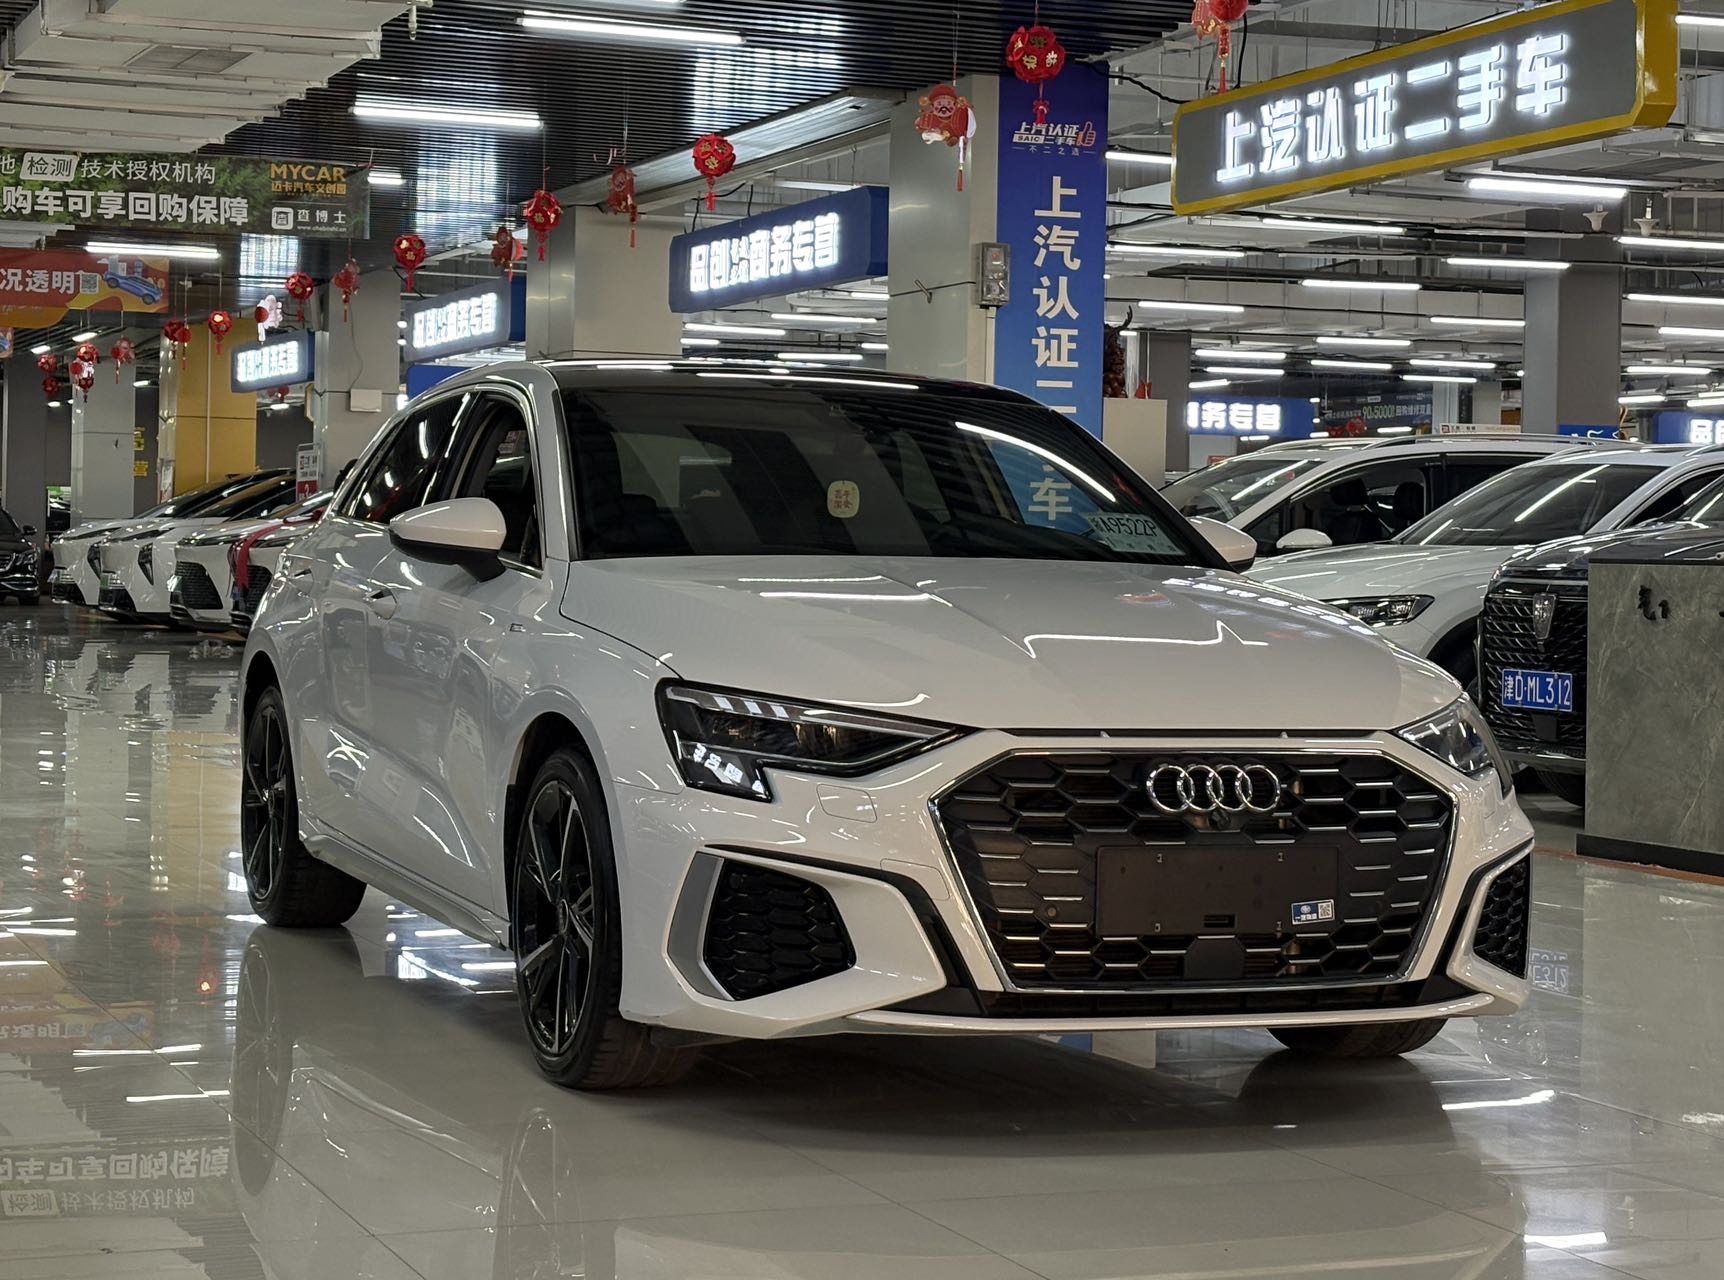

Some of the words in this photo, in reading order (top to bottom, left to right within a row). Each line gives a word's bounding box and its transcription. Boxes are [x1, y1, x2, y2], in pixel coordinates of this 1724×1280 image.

[1216, 33, 1568, 182] 上汽认证二手车
[1014, 121, 1080, 137] 上汽认证
[1015, 135, 1043, 143] SAIC
[1044, 136, 1078, 146] 二手车
[26, 156, 75, 178] 检测
[81, 159, 216, 185] 技术授权机构
[271, 163, 347, 182] MYCAR
[2, 185, 250, 226] 购车可享回购保障
